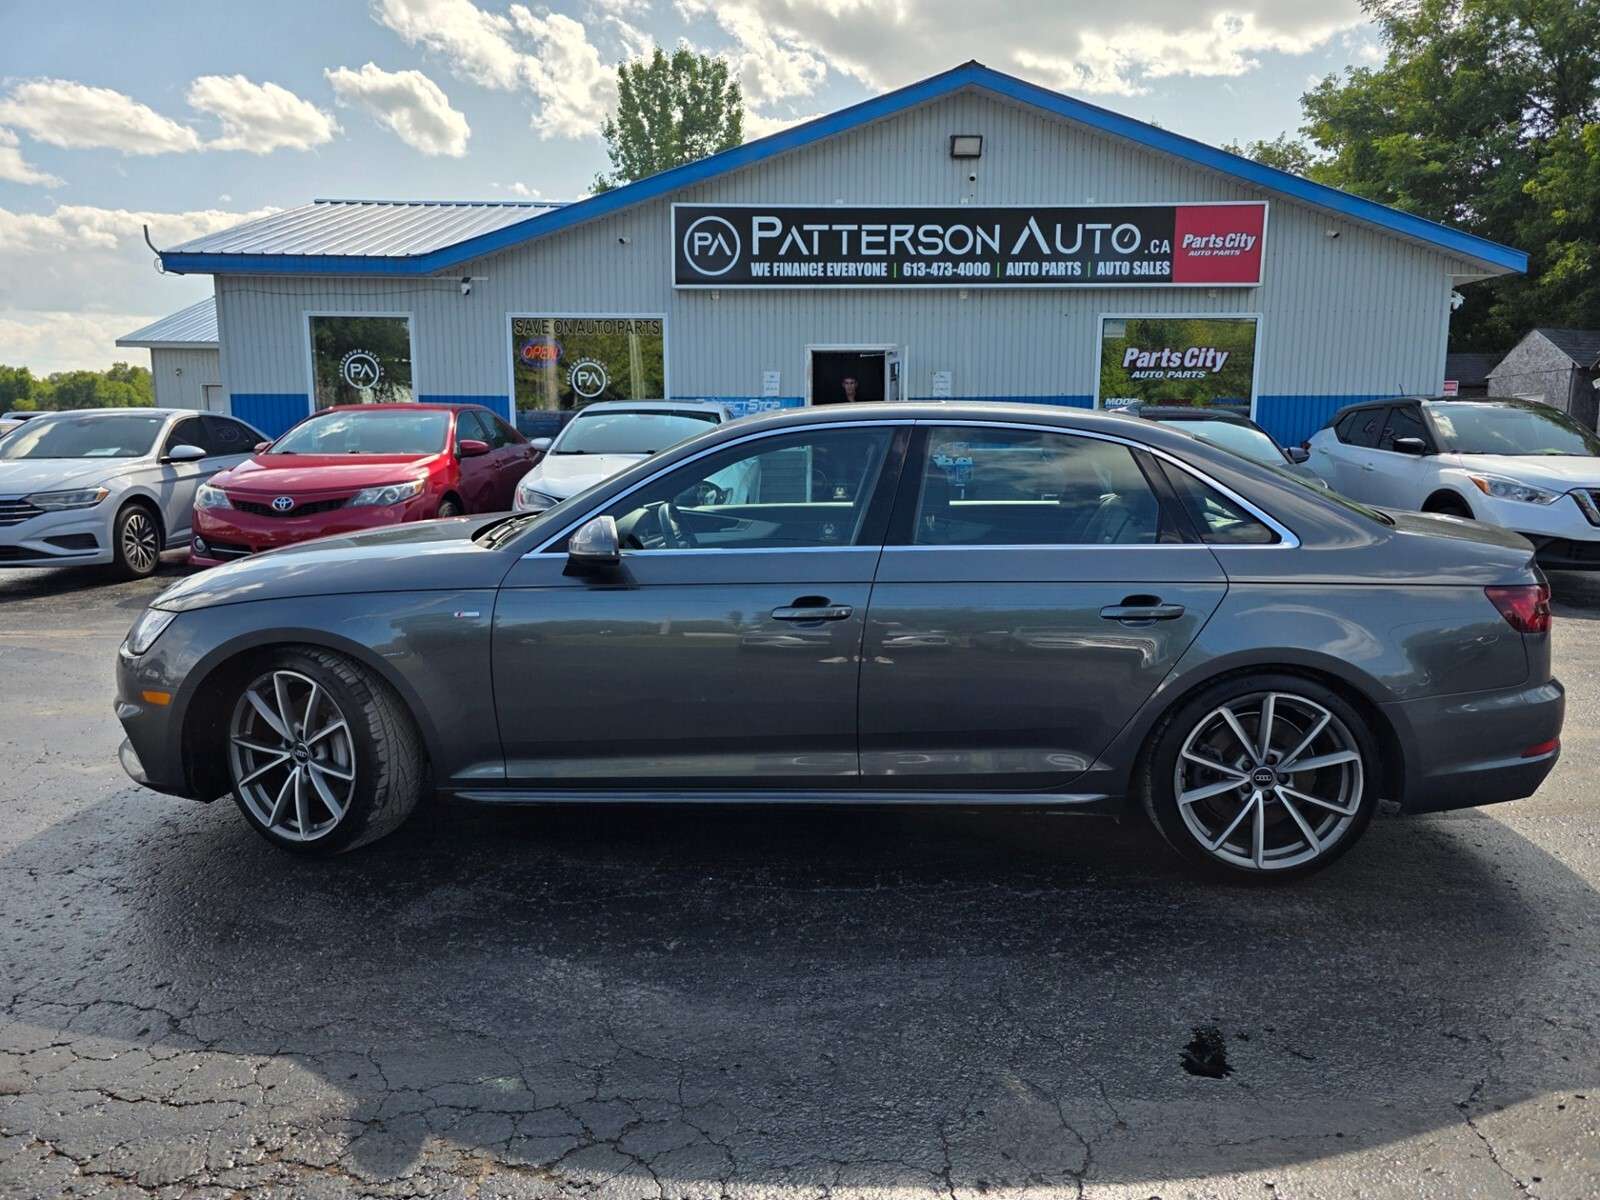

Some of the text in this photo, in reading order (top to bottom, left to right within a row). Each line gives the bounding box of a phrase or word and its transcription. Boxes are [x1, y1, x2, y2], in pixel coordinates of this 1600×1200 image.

[752, 216, 1000, 255] PATTERSON
[1010, 215, 1141, 255] AUTO
[1181, 232, 1257, 251] PartsCity
[693, 232, 732, 256] PA
[1187, 249, 1240, 257] AUTO PARTS
[750, 261, 1171, 277] WE FINANCE EVERYONE 613-473-4000 AUTO PARTS AUTO SALES
[514, 319, 661, 335] SAVE ON AUTO PARTS
[523, 345, 558, 360] OPEN
[1122, 346, 1230, 372] PartsCity
[350, 363, 374, 378] PA
[577, 371, 601, 386] PA
[1131, 370, 1206, 379] AUTO PARTS
